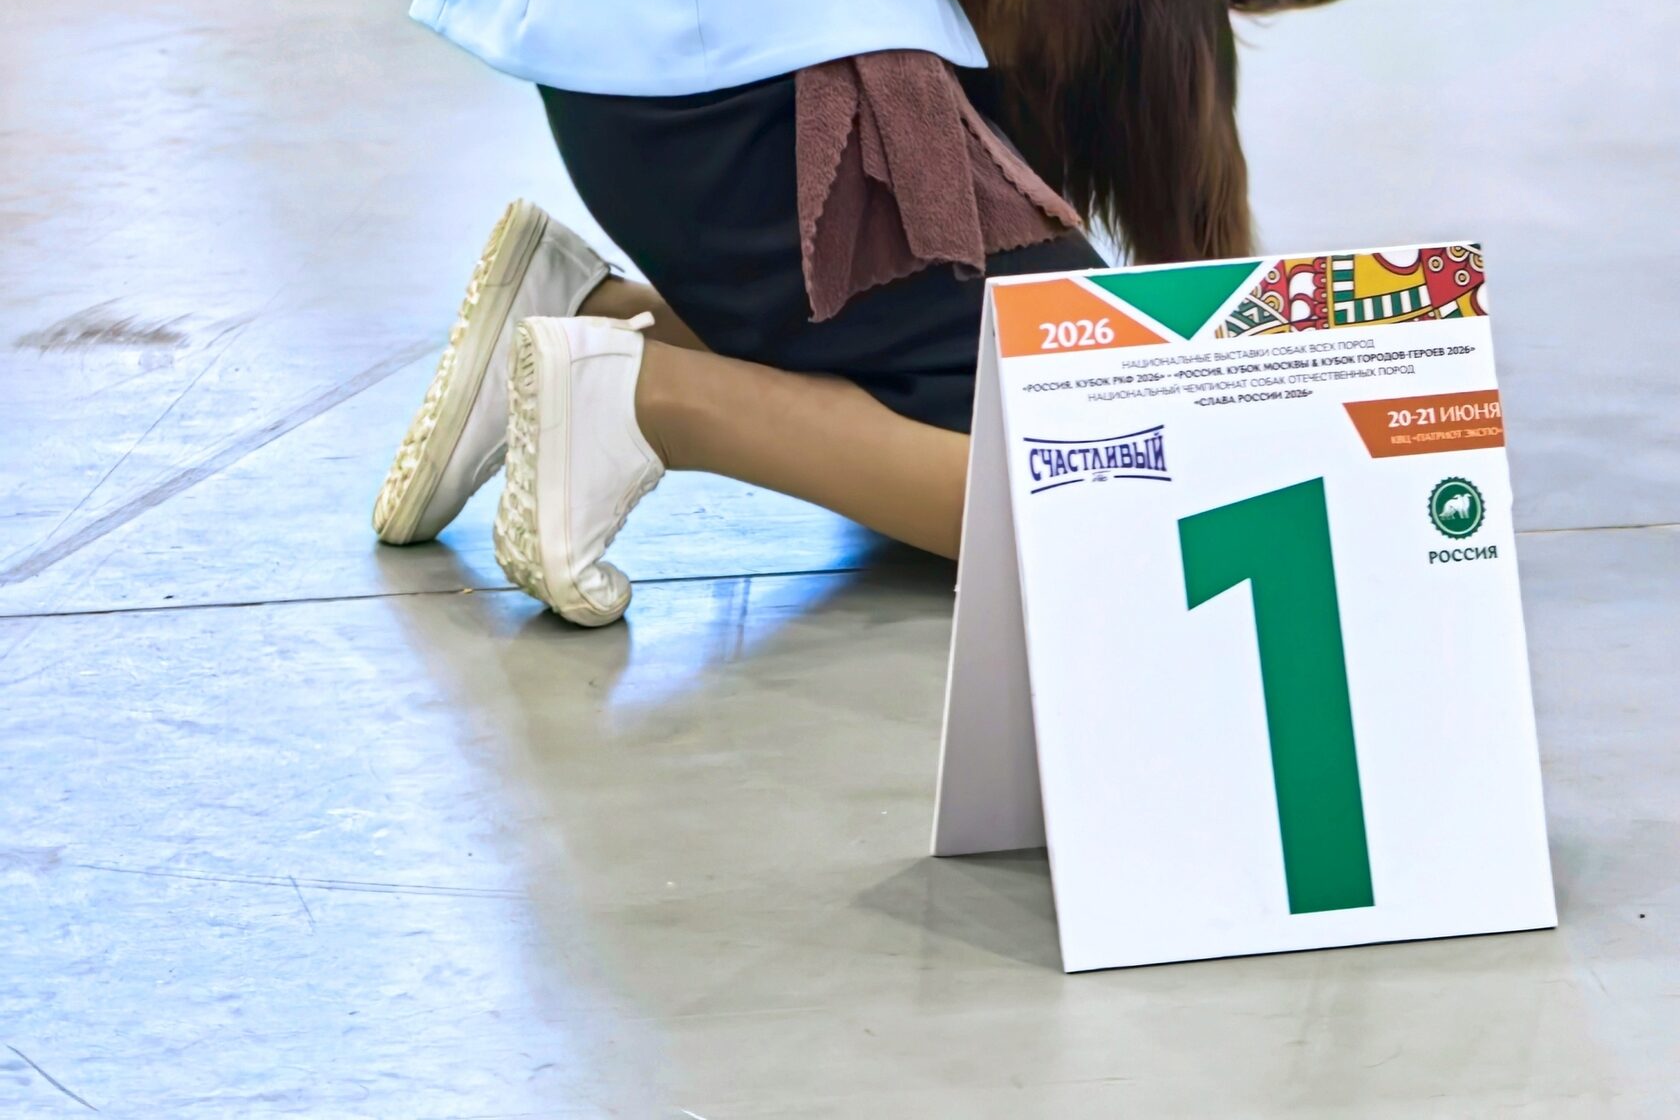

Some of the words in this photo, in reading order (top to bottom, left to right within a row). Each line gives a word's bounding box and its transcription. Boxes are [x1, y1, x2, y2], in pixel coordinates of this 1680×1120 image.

[1038, 317, 1115, 350] 2026
[1075, 377, 1110, 388] КУБОК
[1226, 363, 1261, 375] КУБОК
[1263, 358, 1310, 371] МОСКВЫ
[1311, 358, 1319, 367] &
[1321, 355, 1356, 367] КУБОК
[1357, 347, 1445, 365] ГОРОДОВ-ГЕРОЕВ
[1121, 353, 1211, 369] НАЦИОНАЛЬНЫЕ
[1213, 346, 1270, 362] ВЫСТАВКИ
[1271, 344, 1307, 357] СОБАК
[1309, 342, 1335, 353] ВСЕХ
[1337, 339, 1376, 351] ПОРОД
[1088, 384, 1181, 402] НАЦИОНАЛЬНЫЙ
[1183, 379, 1248, 394] ЧЕМПИОНАТ
[1250, 374, 1286, 388] СОБАК
[1288, 367, 1376, 385] ОТЕЧЕСТВЕННЫХ
[1378, 365, 1415, 377] ПОРОД
[1237, 391, 1283, 403] РОССИИ
[1387, 407, 1435, 428] 20-21
[1439, 401, 1502, 423] ИЮНЯ
[1029, 432, 1167, 481] СЧАСТЛИВЫЙ
[1428, 545, 1499, 564] РОССИЯ
[1177, 477, 1374, 915] 1
